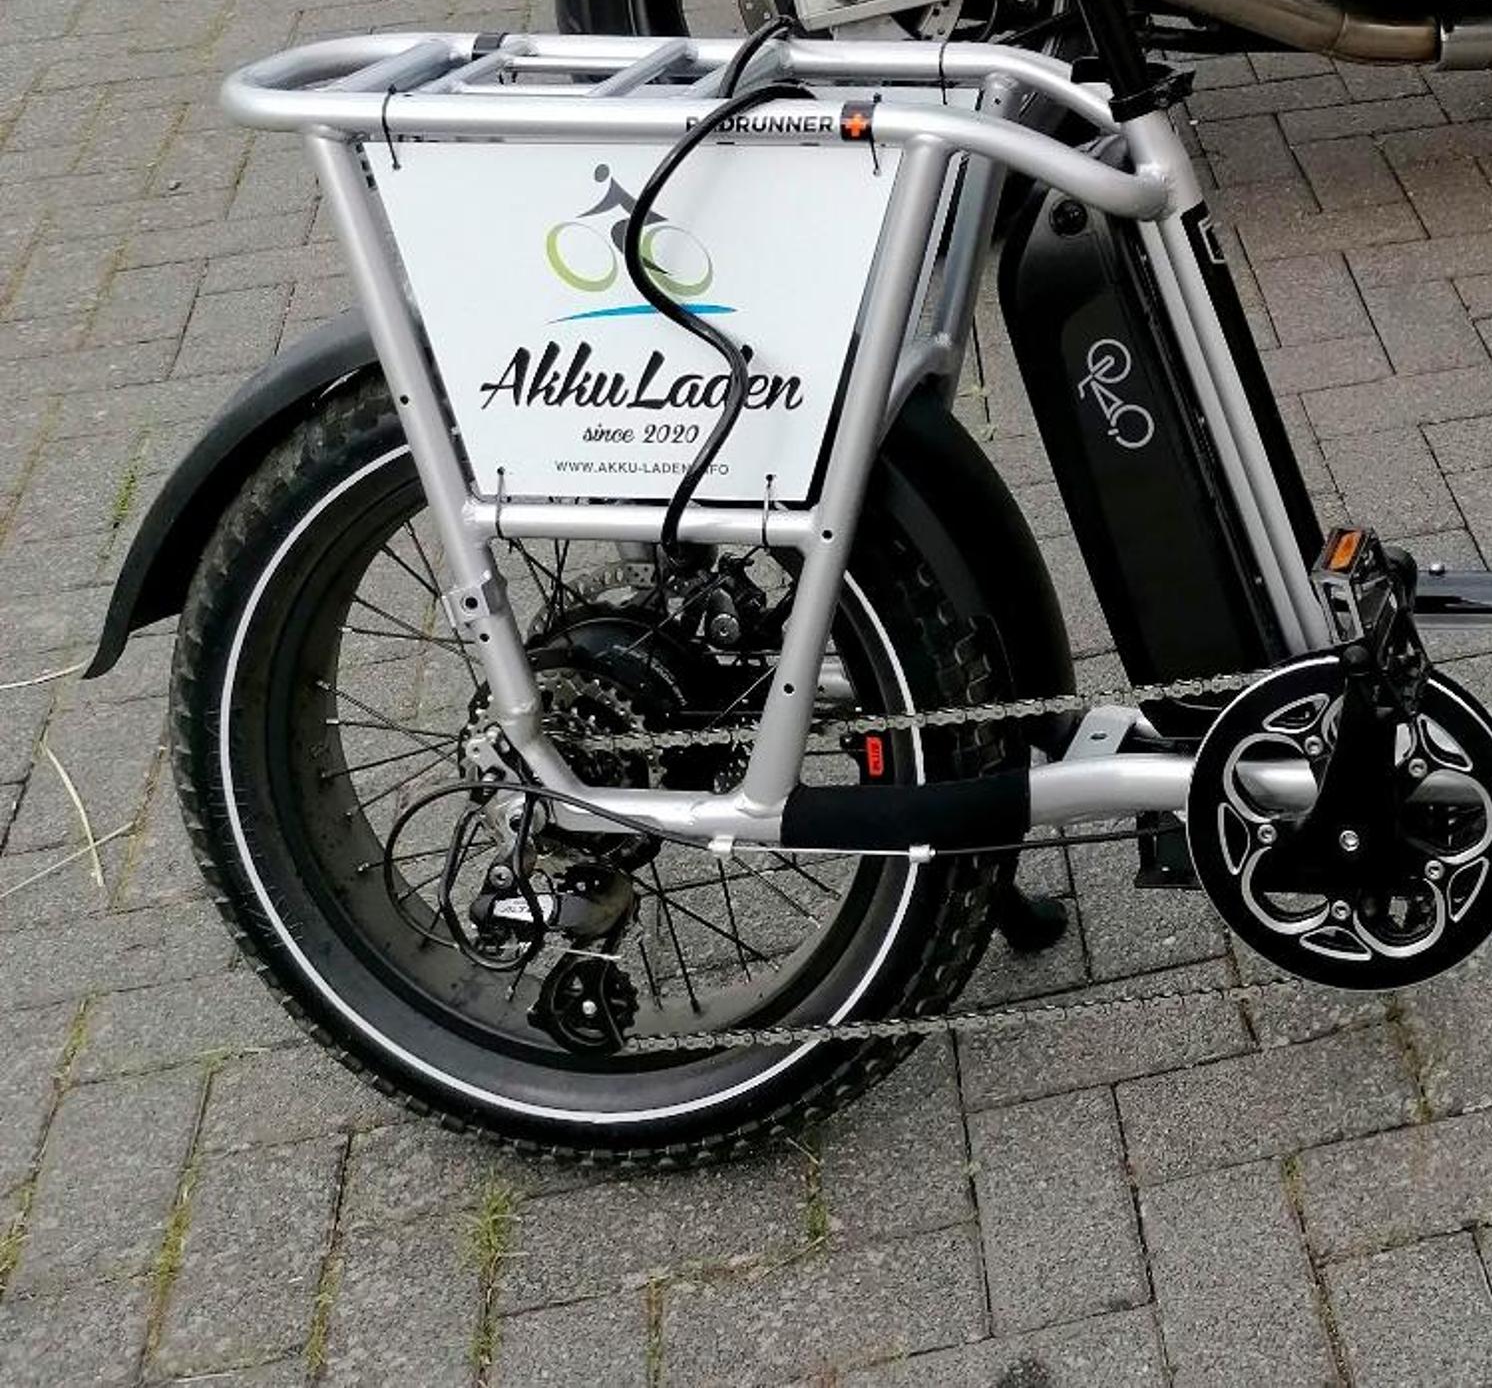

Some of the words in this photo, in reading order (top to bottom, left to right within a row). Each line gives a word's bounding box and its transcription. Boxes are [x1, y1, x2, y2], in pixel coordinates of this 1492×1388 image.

[686, 116, 833, 133] RDRUNNER
[583, 423, 635, 443] since
[642, 424, 700, 443] 2020
